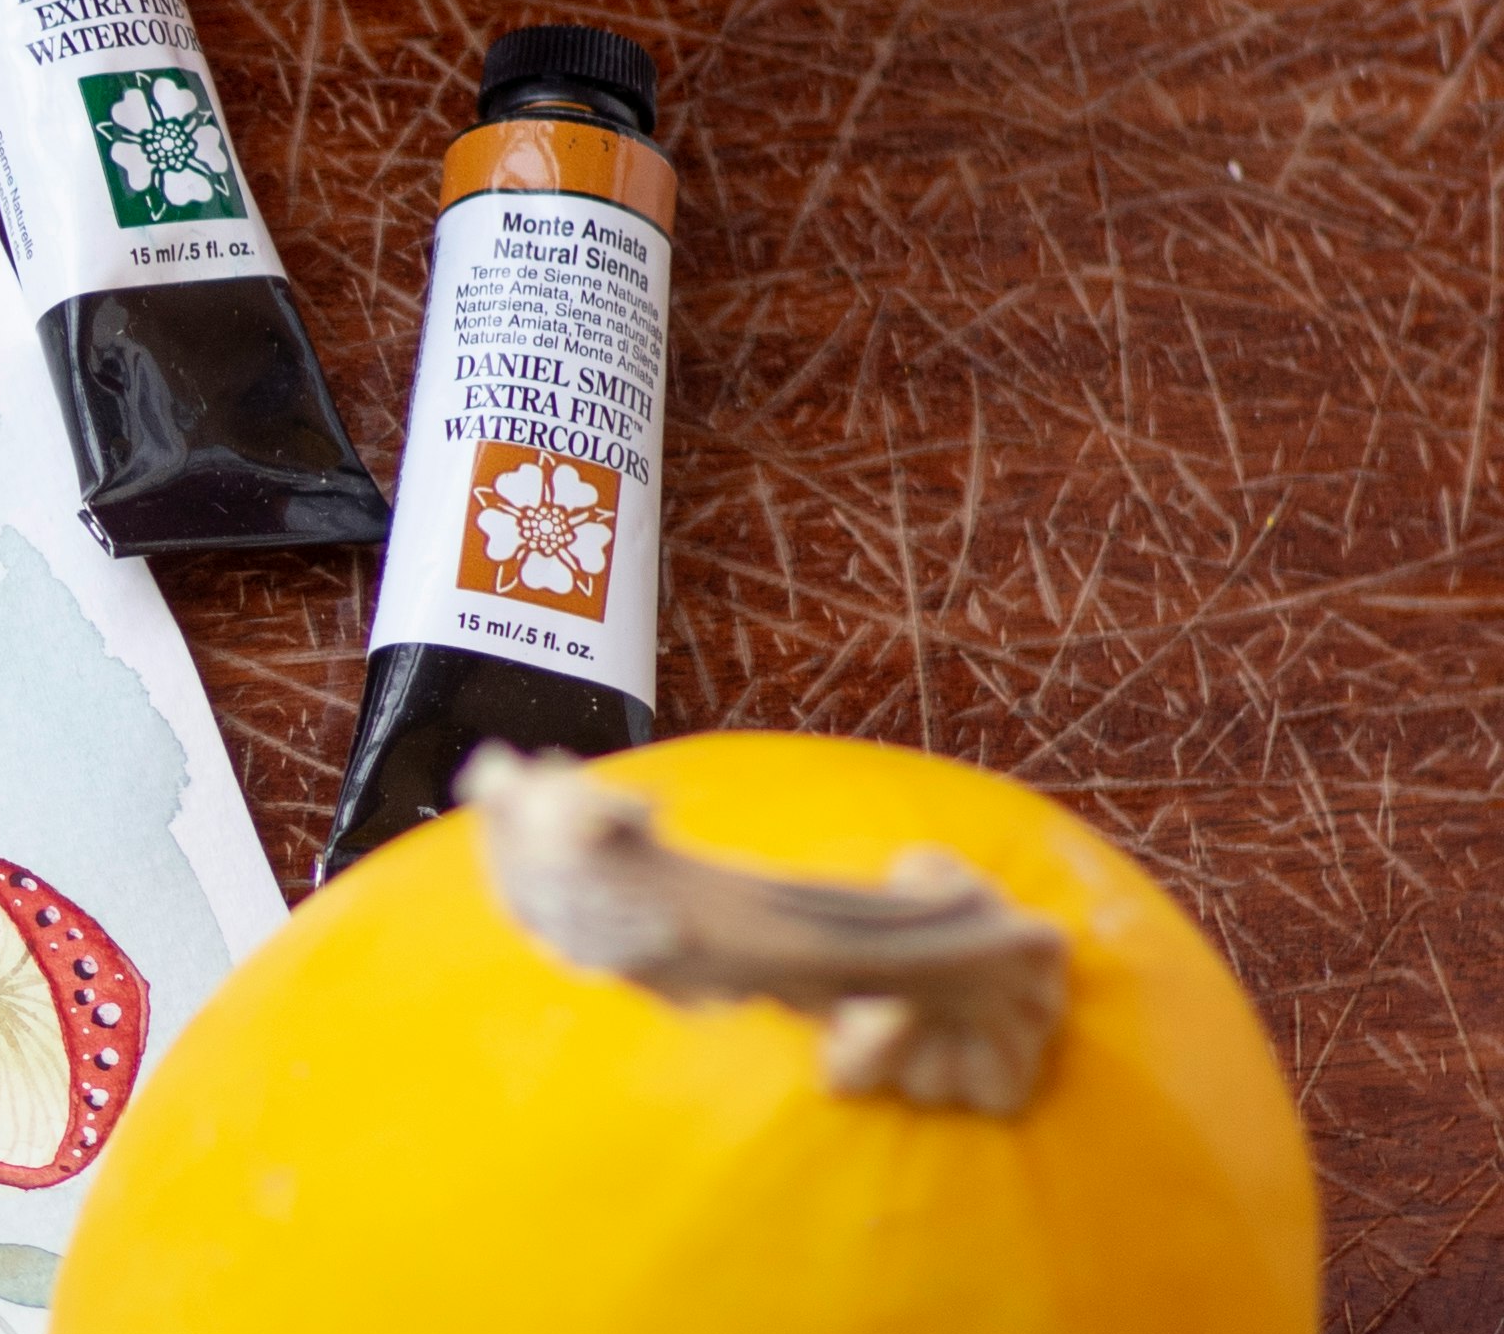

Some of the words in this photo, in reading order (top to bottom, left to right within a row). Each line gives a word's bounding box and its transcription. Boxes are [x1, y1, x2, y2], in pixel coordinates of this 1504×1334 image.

[25, 19, 203, 66] WATERCOLOR
[10, 187, 34, 260] Naturelle
[502, 211, 574, 237] Monte
[581, 219, 647, 264] Amiata
[130, 248, 150, 265] 15
[205, 240, 224, 259] fl.
[228, 242, 255, 256] oz.
[493, 237, 578, 266] Natural
[585, 247, 648, 294] Sienna
[455, 283, 503, 300] Monte
[509, 280, 573, 303] Amiata,
[580, 290, 626, 317] Monte
[630, 312, 663, 345] Amiata
[471, 266, 510, 280] Terre
[517, 265, 537, 279] de
[543, 268, 602, 291] Sienne
[607, 280, 659, 321] Naturelle
[454, 314, 502, 332] Monte
[617, 338, 629, 353] di
[631, 346, 659, 376] Siena
[455, 299, 548, 316] Natursiena,
[555, 302, 602, 326] Siena
[607, 318, 648, 347] natural
[649, 339, 661, 359] de
[454, 352, 570, 387] DANIEL
[577, 367, 652, 424] SMITH
[458, 331, 527, 347] Naturale
[533, 333, 559, 349] del
[564, 339, 613, 365] Monte
[617, 357, 654, 388] Amiata
[463, 383, 561, 419] EXTRA
[444, 414, 649, 486] WATERCOLORS
[457, 612, 480, 631] 15
[544, 631, 560, 652] fl.
[566, 640, 595, 661] oz.
